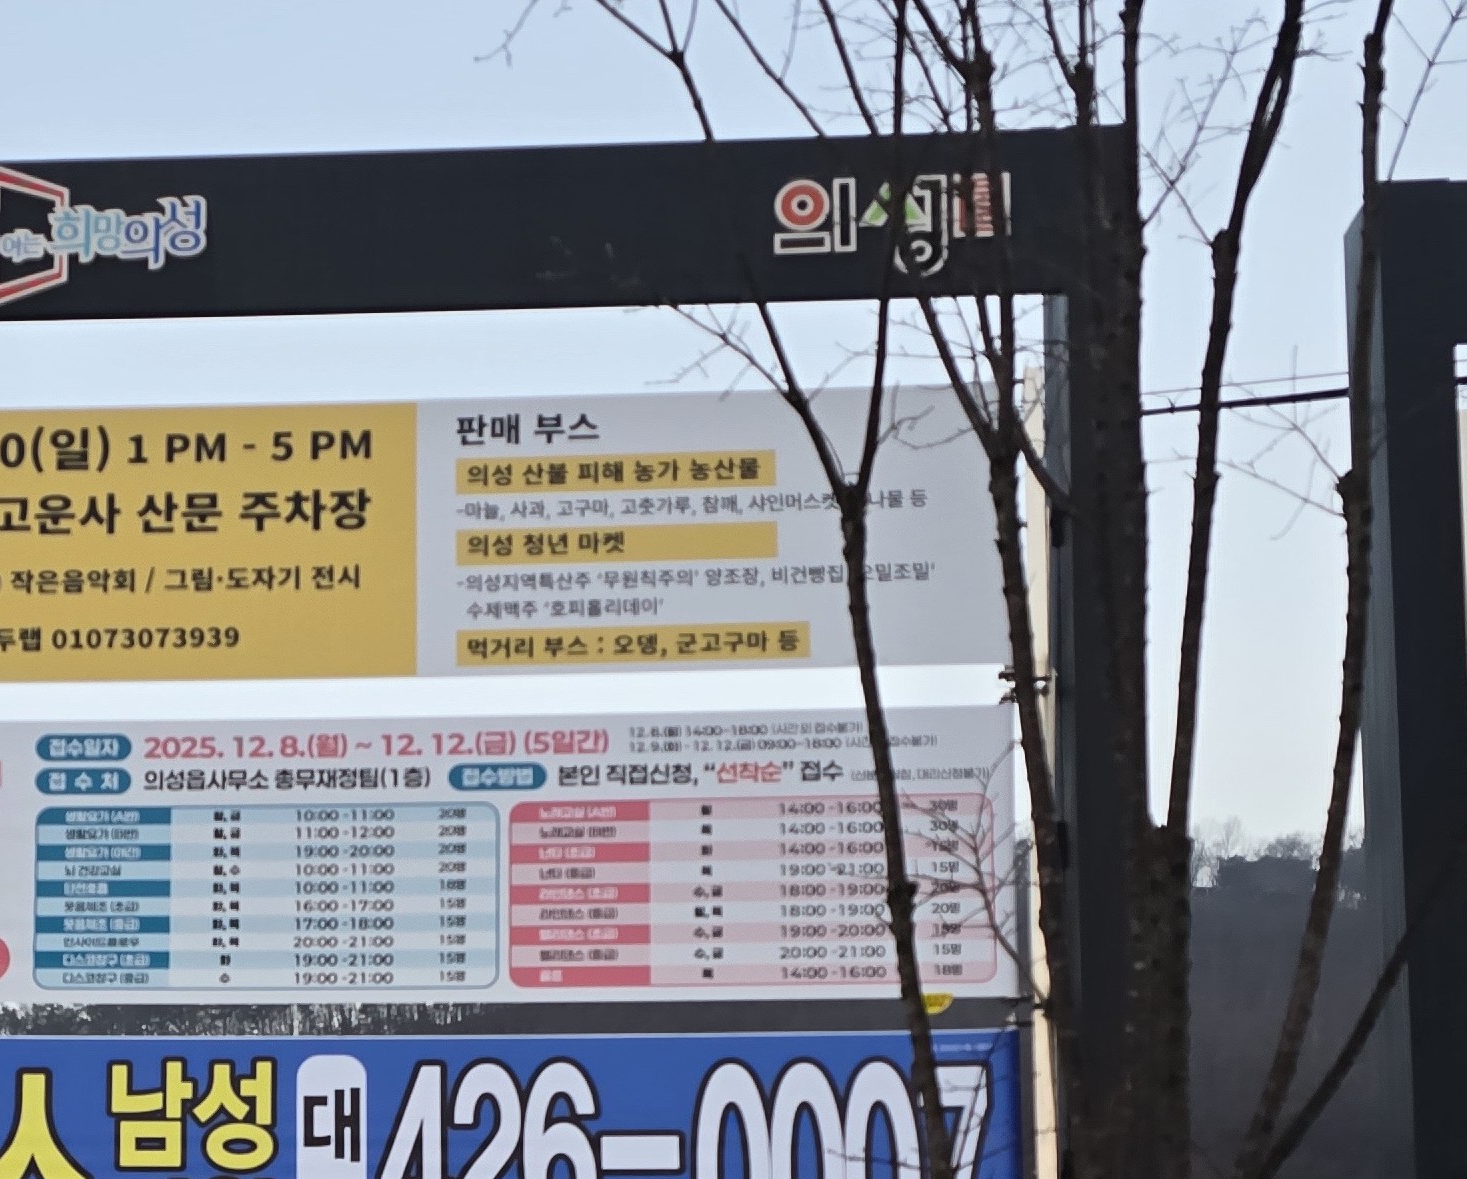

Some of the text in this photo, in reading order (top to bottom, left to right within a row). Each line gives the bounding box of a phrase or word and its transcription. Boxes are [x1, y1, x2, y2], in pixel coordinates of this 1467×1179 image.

[456, 413, 600, 445] 판매 부스
[128, 434, 149, 464] 1
[166, 432, 227, 462] PM
[271, 430, 293, 461] 5
[311, 429, 372, 460] PM
[467, 457, 761, 487] 의성 산불 피해 농가 농산물
[137, 491, 223, 534] 산문
[239, 487, 372, 532] 주차장
[910, 488, 928, 507] 등
[467, 531, 625, 556] 의성 청년 마켓
[10, 567, 136, 594] 작은음악회
[164, 565, 301, 593] 그림·도자기
[311, 563, 361, 590] 전시
[771, 564, 844, 585] 비건빵집
[466, 601, 537, 620] 수제맥주
[51, 626, 240, 651] 01073073939
[467, 630, 800, 659] 먹거리 부스 오뎅, 군고구마 등
[48, 738, 120, 758] 접수일자
[143, 736, 224, 759] 2025.
[233, 736, 274, 759] 12.
[280, 733, 348, 758] 8.(월)
[382, 733, 422, 757] 12.
[432, 731, 516, 756] 12.(금)
[524, 729, 610, 755] (5일간)
[144, 769, 270, 790] 의성읍사무소
[275, 766, 430, 789] 총무재정팀(1층)
[462, 767, 532, 787] 접수방법
[558, 765, 601, 786] 본인
[800, 760, 843, 783] 접수
[105, 1057, 277, 1170] 남성
